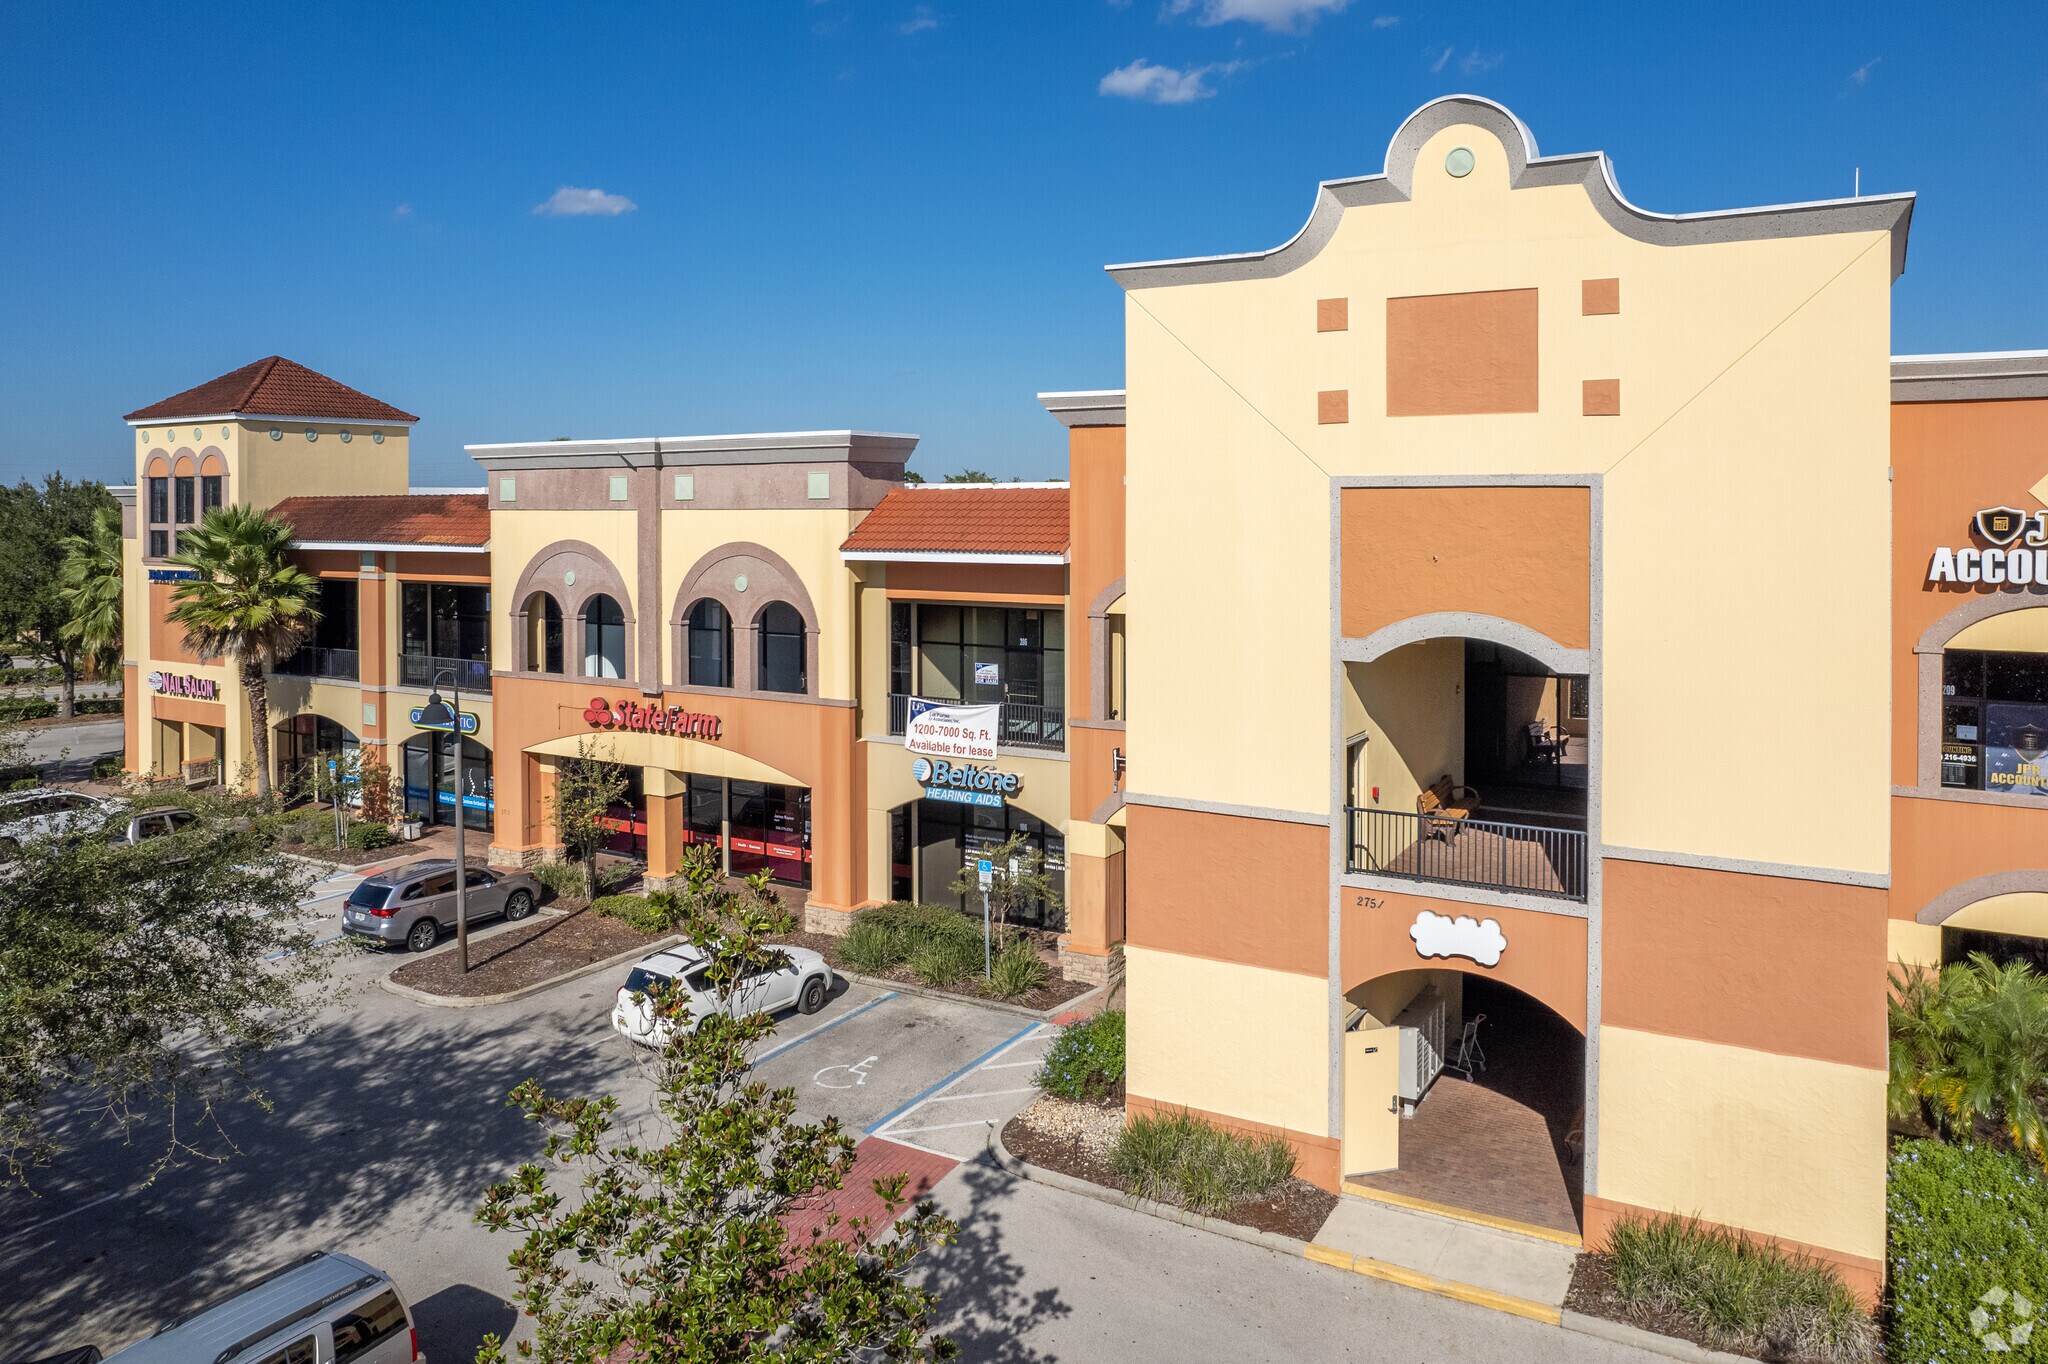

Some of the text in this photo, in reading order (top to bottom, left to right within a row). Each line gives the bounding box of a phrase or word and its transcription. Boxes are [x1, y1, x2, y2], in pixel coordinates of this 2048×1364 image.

[161, 672, 214, 697] NAIL SALON
[914, 723, 991, 741] 1200-7000 Sq. Ft.
[908, 738, 994, 757] Available for lease
[931, 760, 1017, 792] Beltone
[2016, 763, 2041, 775] JPR
[926, 788, 1001, 806] HEARING AIDS
